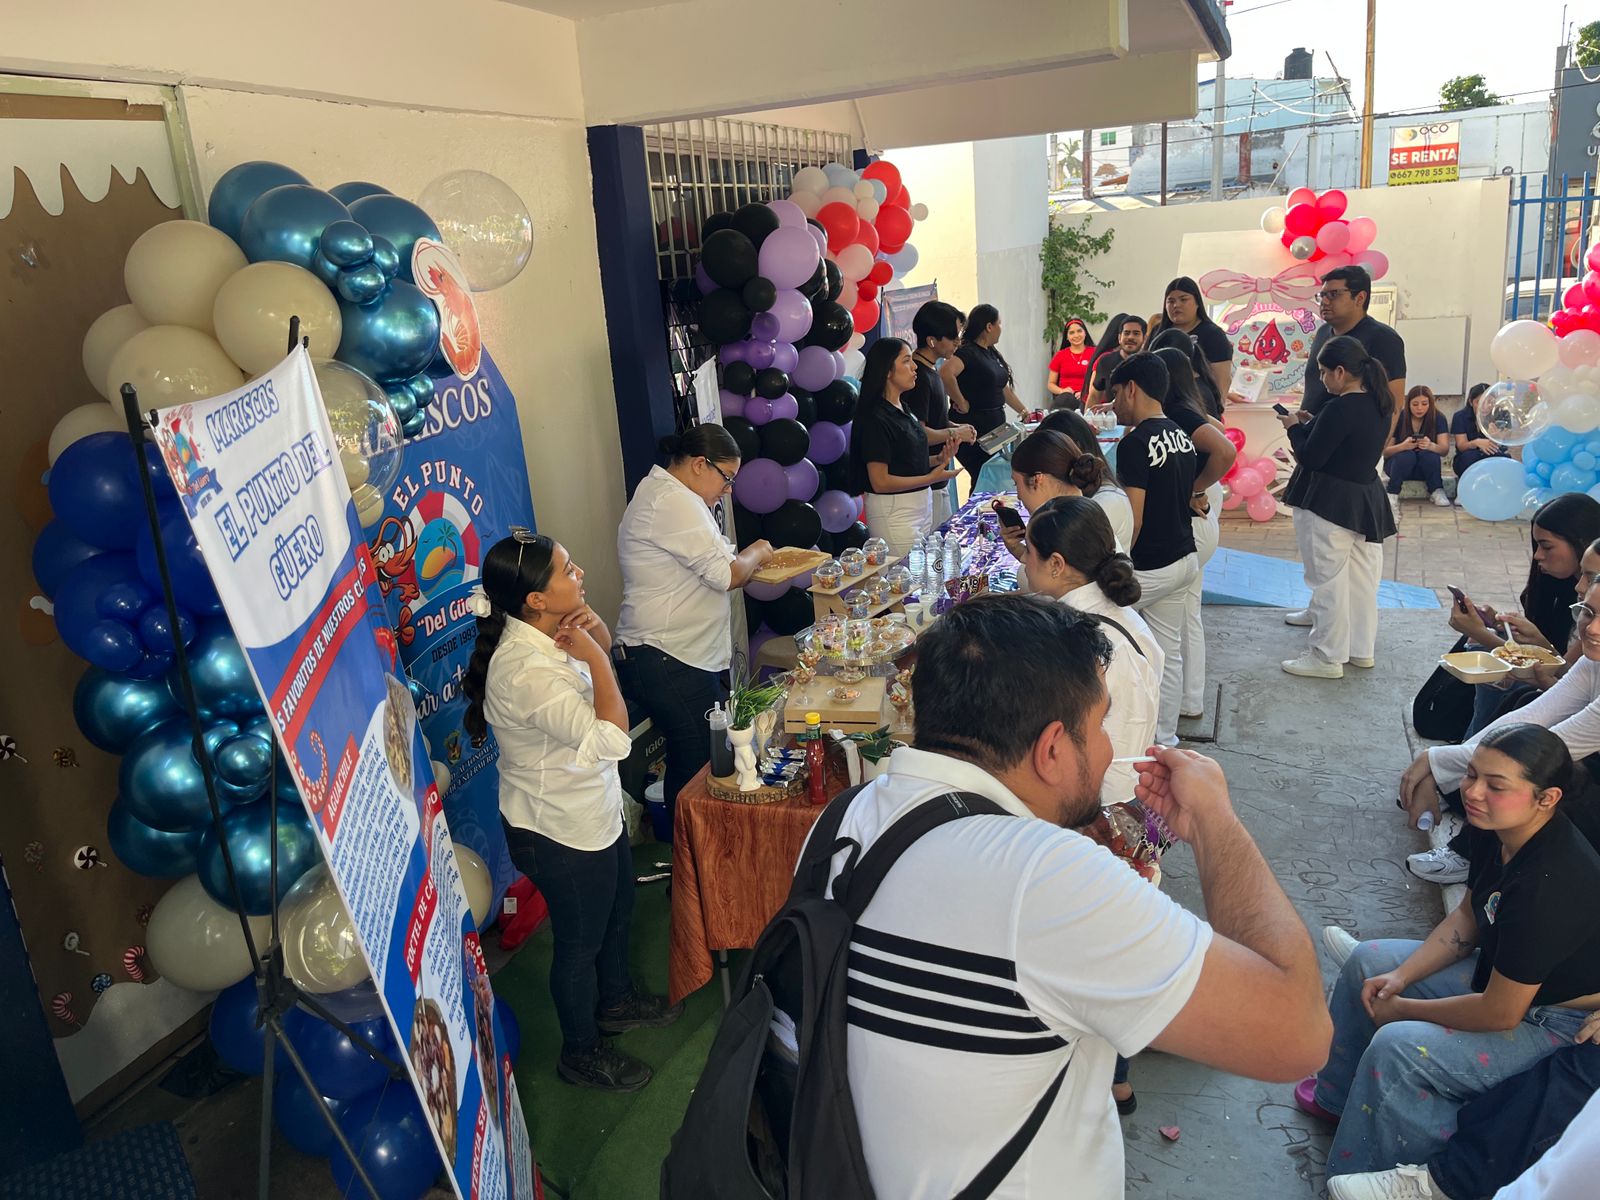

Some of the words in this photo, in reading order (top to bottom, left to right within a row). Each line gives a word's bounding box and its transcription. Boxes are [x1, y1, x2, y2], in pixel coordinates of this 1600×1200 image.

[1391, 152, 1408, 165] SE
[1411, 148, 1457, 164] RENTA
[1397, 170, 1412, 179] 667
[1415, 168, 1430, 178] 798
[1433, 167, 1443, 176] 55
[1446, 166, 1456, 175] 35
[205, 379, 280, 453] MARISCOS
[214, 503, 250, 562] EL
[235, 452, 301, 538] PUNTO
[292, 431, 333, 484] DEL
[392, 475, 419, 511] EL
[420, 460, 483, 516] PUNTO
[269, 514, 325, 601] GÜERO
[281, 650, 317, 723] FAVORITOS
[313, 634, 326, 660] DE
[321, 590, 355, 647] NUESTROS
[431, 639, 458, 663] DESDE
[460, 625, 478, 646] 1993
[327, 748, 352, 823] AGUACHILE
[406, 918, 424, 974] COCTEL
[417, 898, 428, 921] DE
